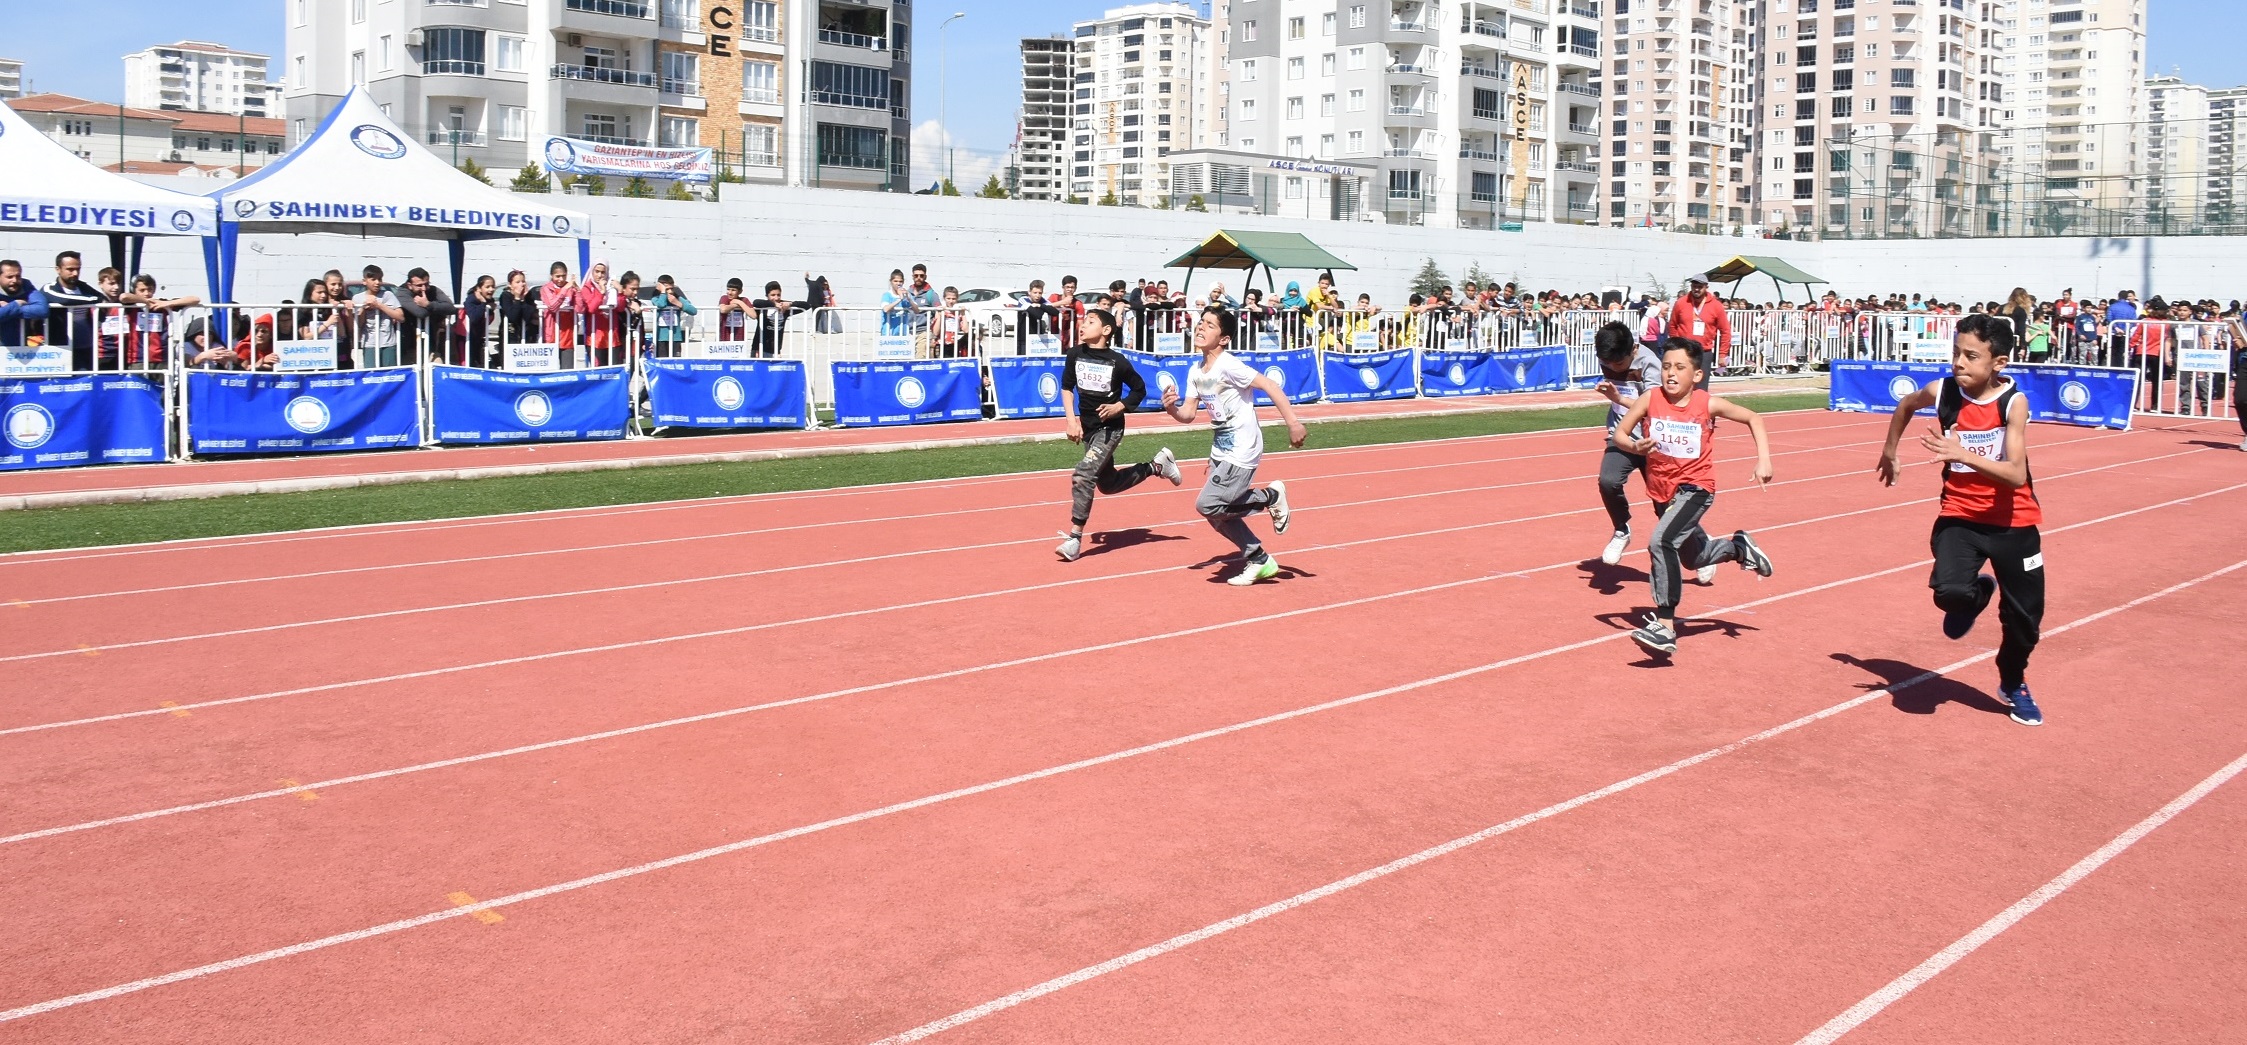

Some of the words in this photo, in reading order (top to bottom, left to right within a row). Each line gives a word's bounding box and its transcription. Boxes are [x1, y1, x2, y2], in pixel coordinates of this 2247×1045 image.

[1516, 76, 1527, 141] ASCE
[1269, 161, 1294, 170] ASCE
[1082, 372, 1102, 382] 1632
[1660, 433, 1689, 446] 1145
